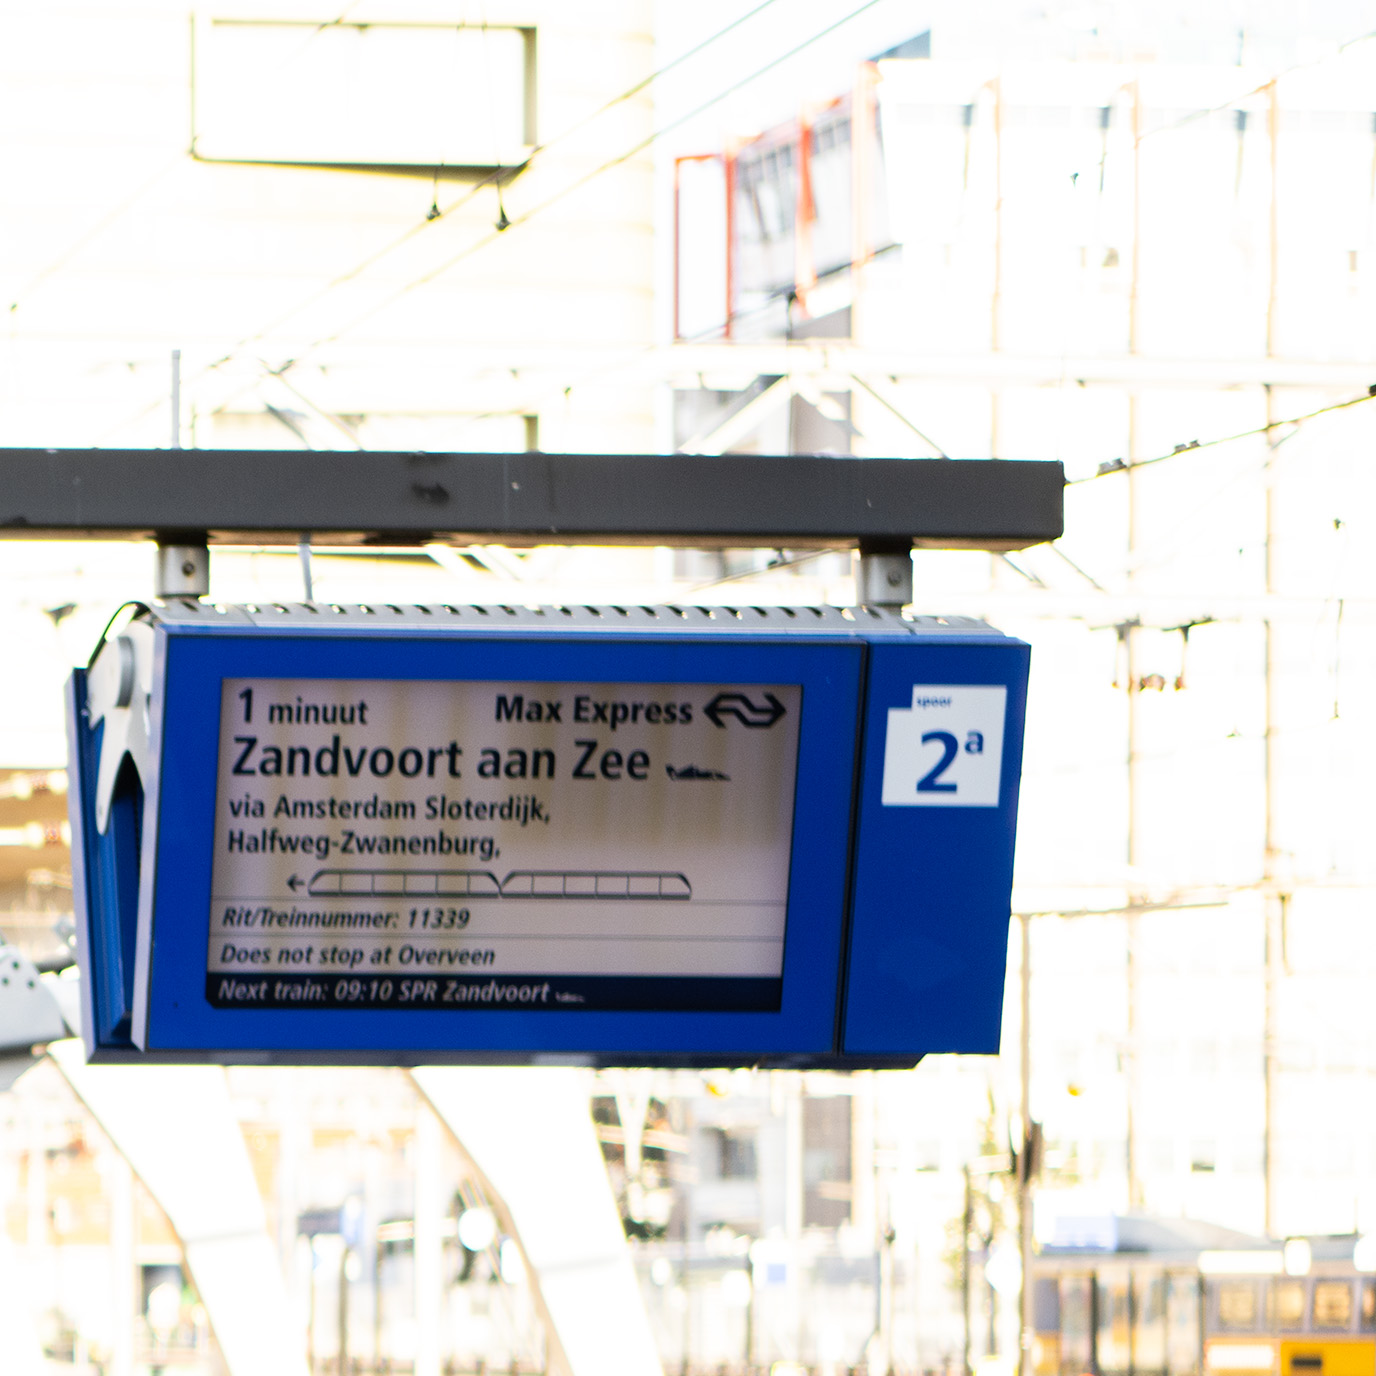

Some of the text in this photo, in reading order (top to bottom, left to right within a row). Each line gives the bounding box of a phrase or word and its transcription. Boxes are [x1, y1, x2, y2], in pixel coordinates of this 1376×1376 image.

[239, 688, 369, 725] 1 minuut
[495, 695, 693, 731] Max Express
[231, 735, 650, 781] Zandvoort aan Zee
[228, 795, 550, 826] via Amsterdam Sloterdijk,
[228, 831, 501, 861] Halfweg-Zwanenburg,
[221, 906, 470, 931] Rit/Treinnummer: 11339
[220, 944, 495, 968] Does not stop at Overveen
[218, 979, 551, 1003] Next train: 09:10 SPR Zandvoort
